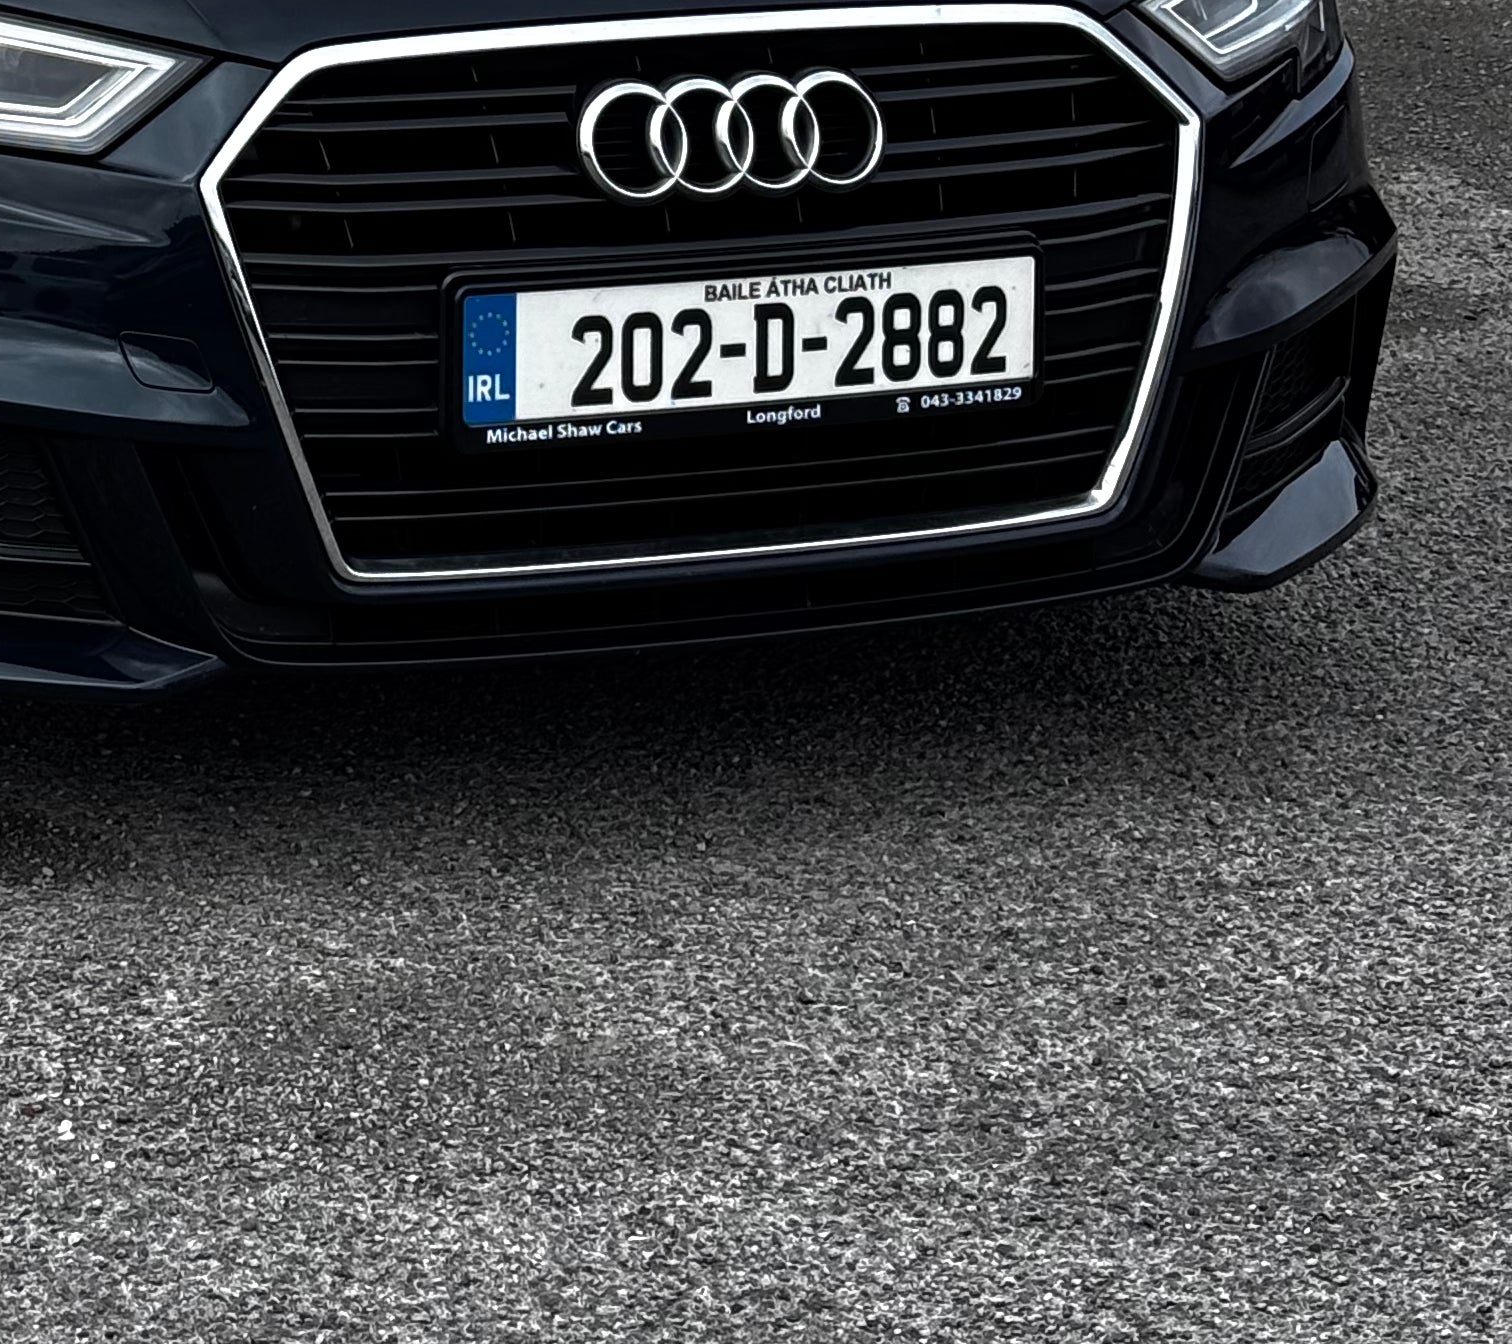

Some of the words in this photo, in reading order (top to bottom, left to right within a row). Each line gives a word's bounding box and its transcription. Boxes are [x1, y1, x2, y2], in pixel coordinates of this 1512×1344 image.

[704, 280, 762, 302] BAILE
[766, 275, 820, 299] ÁTHA
[824, 271, 893, 295] CLIATH
[570, 285, 1008, 408] 202-D-2882
[467, 374, 510, 404] IRL
[921, 385, 1022, 410] 043-3341829
[746, 404, 822, 426] Longford
[486, 424, 554, 444] Michael
[557, 421, 603, 439] Shaw
[606, 418, 642, 436] Cars
